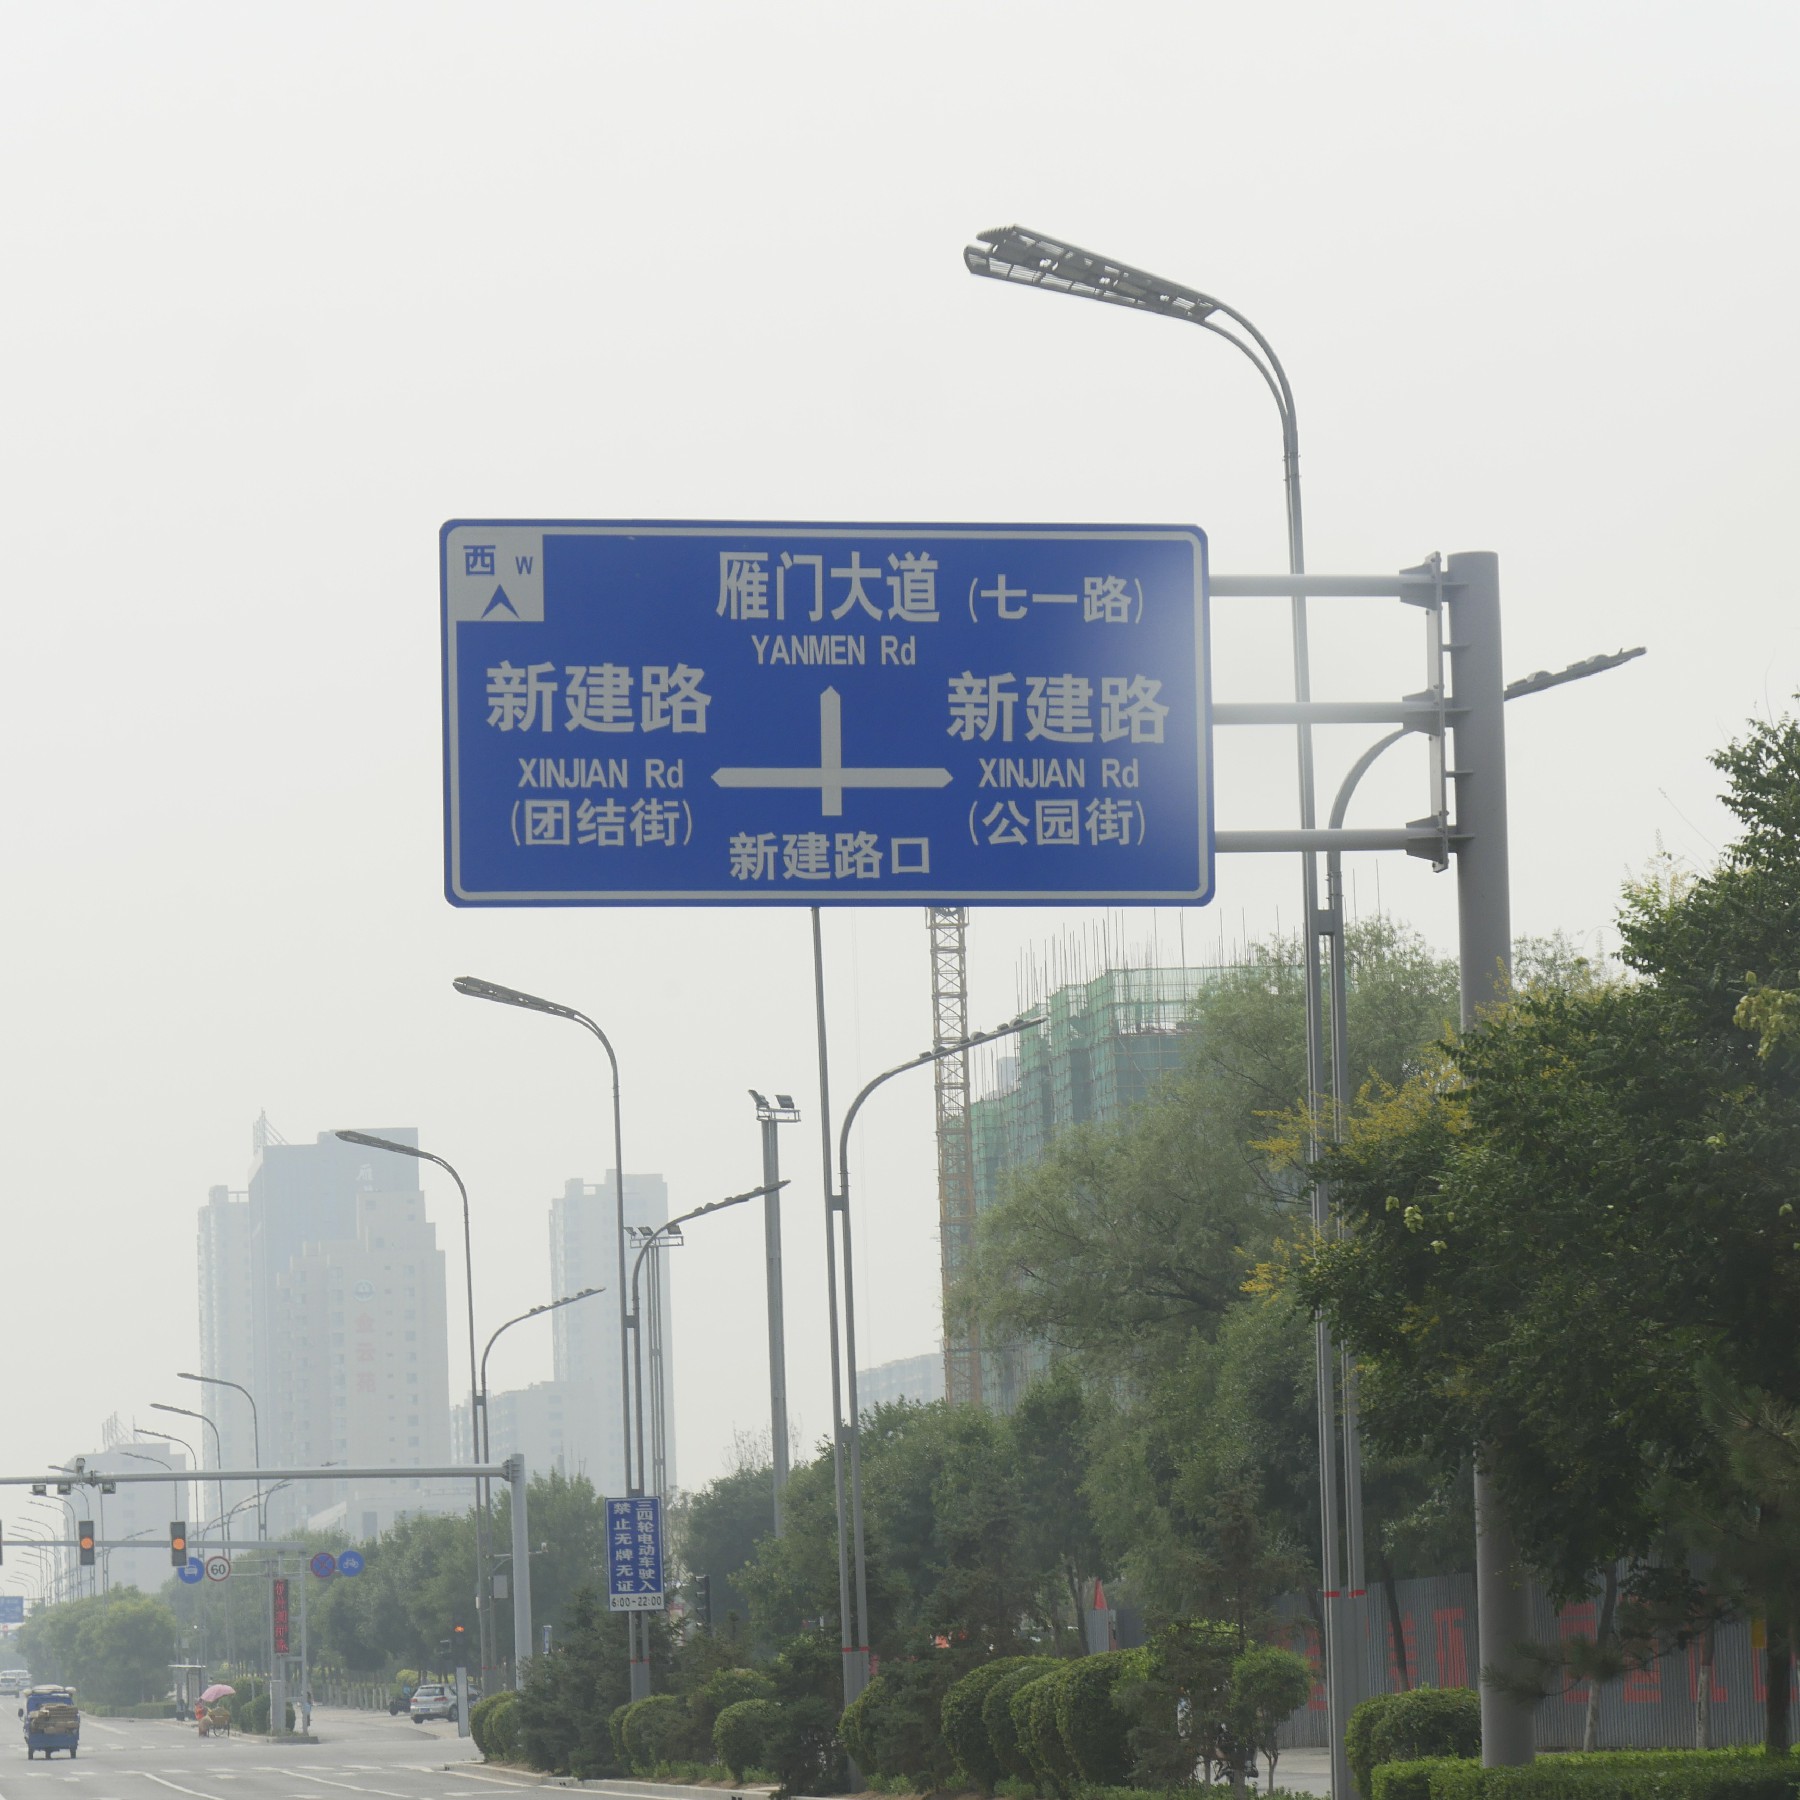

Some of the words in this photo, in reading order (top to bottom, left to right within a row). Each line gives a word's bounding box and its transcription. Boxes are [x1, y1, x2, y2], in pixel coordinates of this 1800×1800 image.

[463, 545, 496, 576] 西
[515, 556, 533, 575] W
[716, 551, 940, 622] 雁门大道
[751, 635, 865, 665] YANMEN
[880, 635, 916, 665] Rd
[486, 660, 712, 733] 新建路
[947, 670, 1170, 743] 新建路
[518, 758, 628, 788] XINJIAN
[645, 758, 684, 788] Rd
[978, 758, 1085, 788] XINJIAN
[1102, 758, 1139, 788] Rd
[729, 830, 930, 881] 新建路口
[613, 1502, 635, 1592] 禁止无牌无证
[635, 1500, 656, 1592] 三四轮电动车驶入
[210, 1564, 226, 1576] 60
